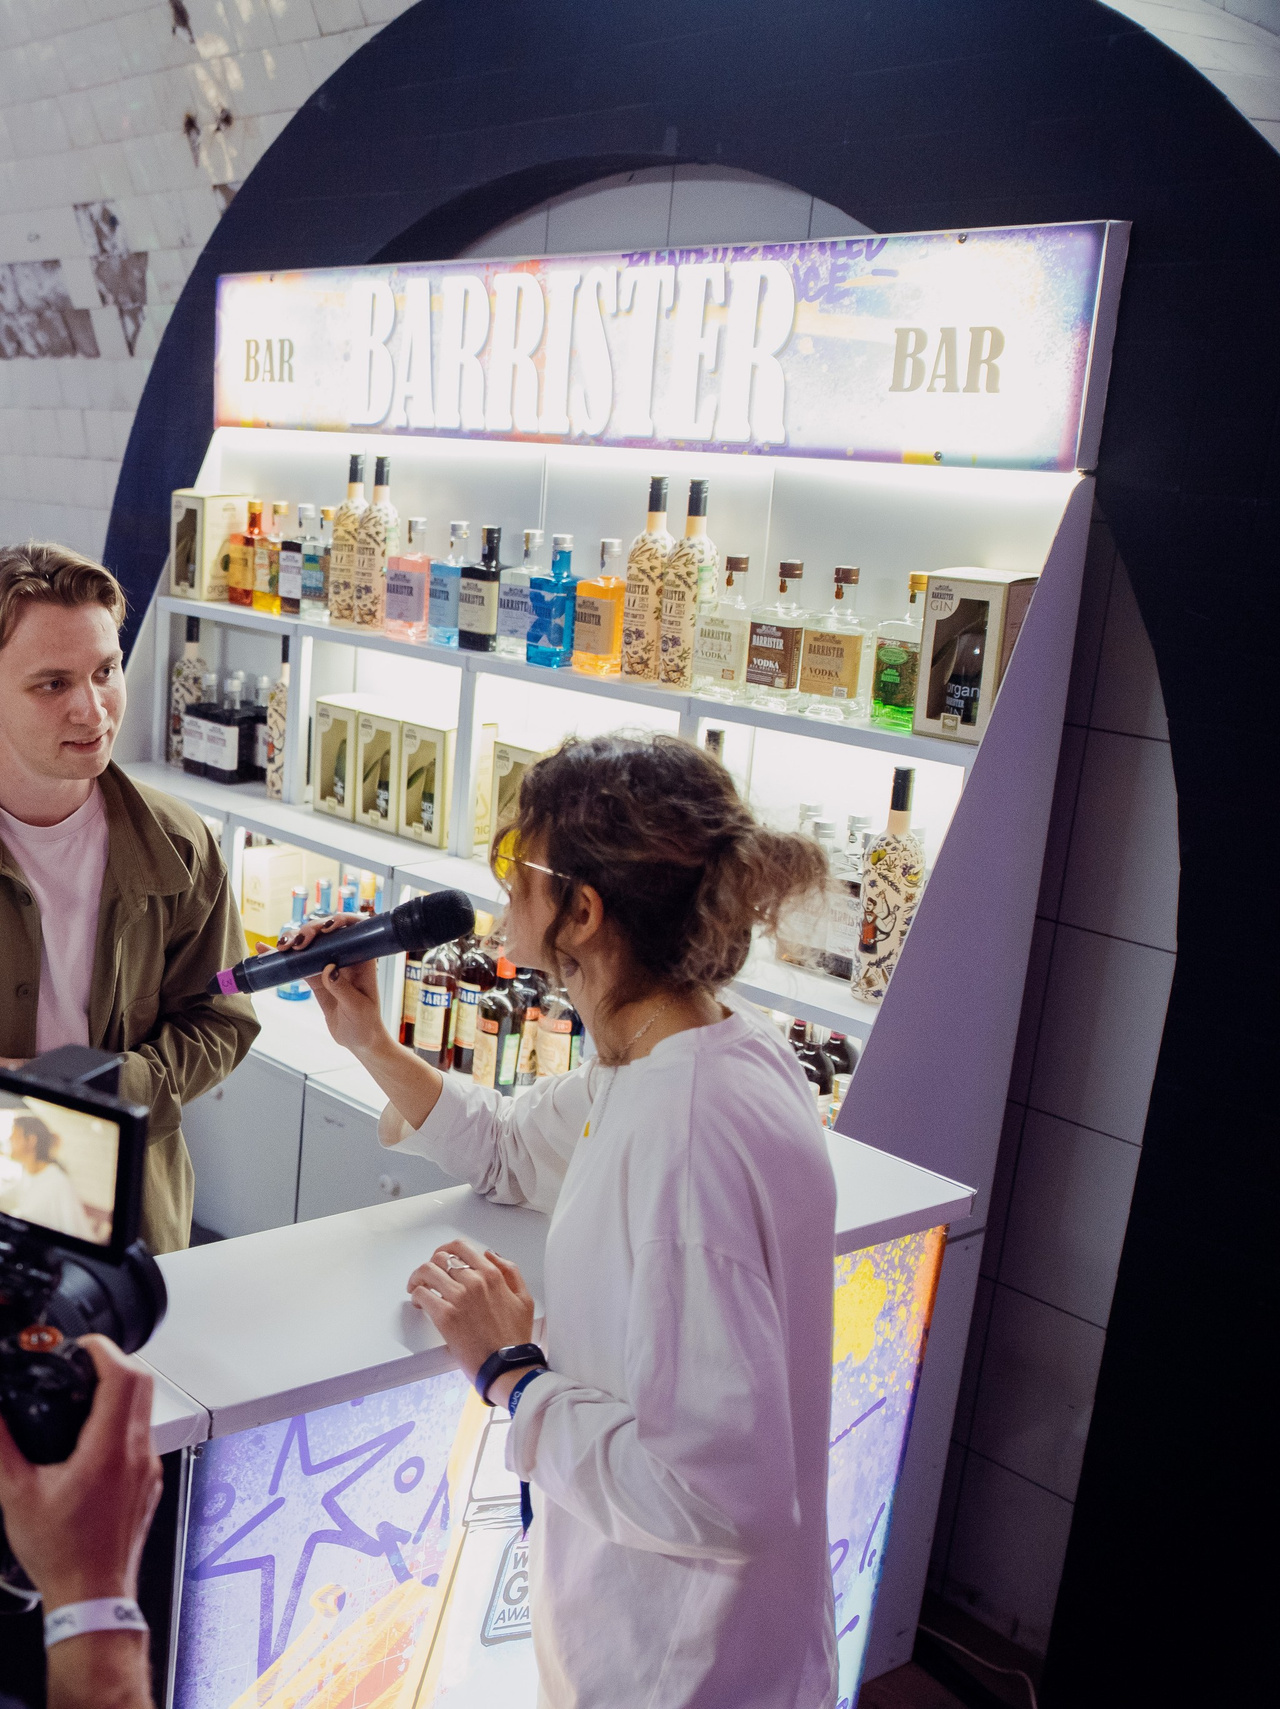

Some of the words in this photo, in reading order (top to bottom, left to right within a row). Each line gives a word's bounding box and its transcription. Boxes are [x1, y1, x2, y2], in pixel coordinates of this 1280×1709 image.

[348, 258, 798, 446] BARRISTER
[888, 326, 1006, 394] BAR
[244, 338, 295, 383] BAR
[930, 600, 954, 612] GIN
[752, 634, 784, 650] BARRISTER
[700, 650, 727, 661] VODKA
[808, 643, 845, 659] BARRISTER
[752, 657, 780, 670] VODKA
[809, 667, 840, 679] VODKA
